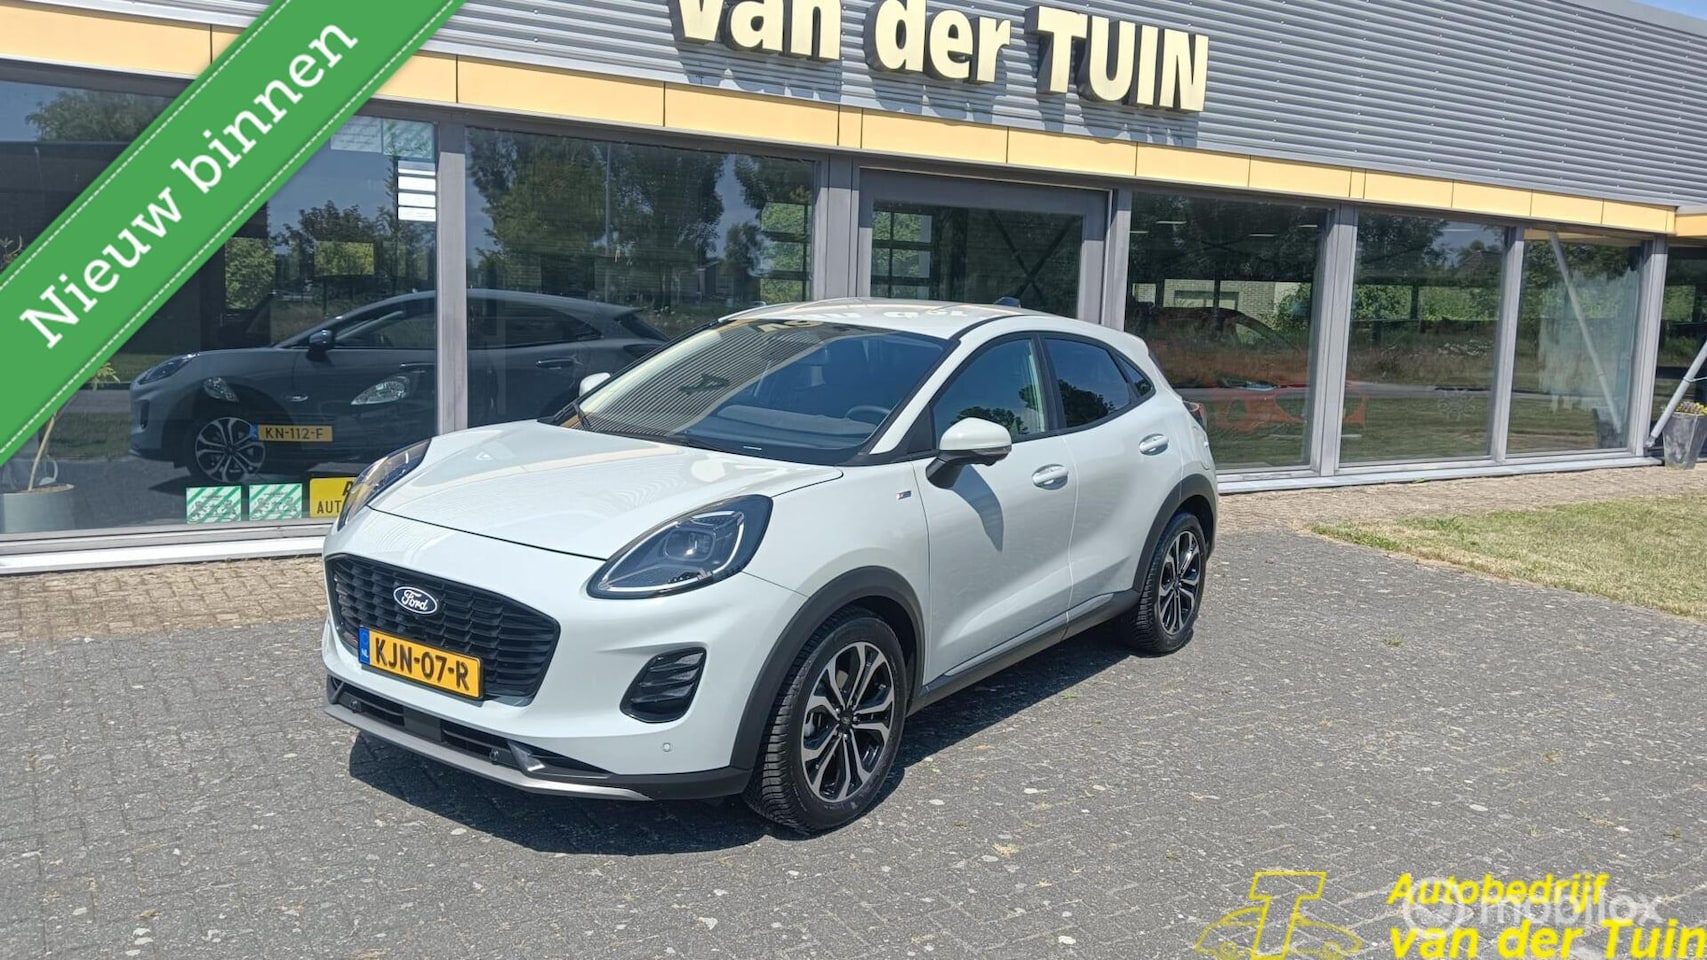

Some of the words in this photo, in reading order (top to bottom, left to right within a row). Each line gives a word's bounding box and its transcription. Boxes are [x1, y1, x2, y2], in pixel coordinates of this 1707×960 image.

[676, 0, 841, 60] van
[874, 0, 1010, 83] der
[1037, 5, 1209, 112] TUIN
[265, 427, 324, 440] KN-112-F
[316, 500, 342, 514] AUT
[401, 589, 429, 612] Ford
[375, 637, 470, 692] KJN-07-R
